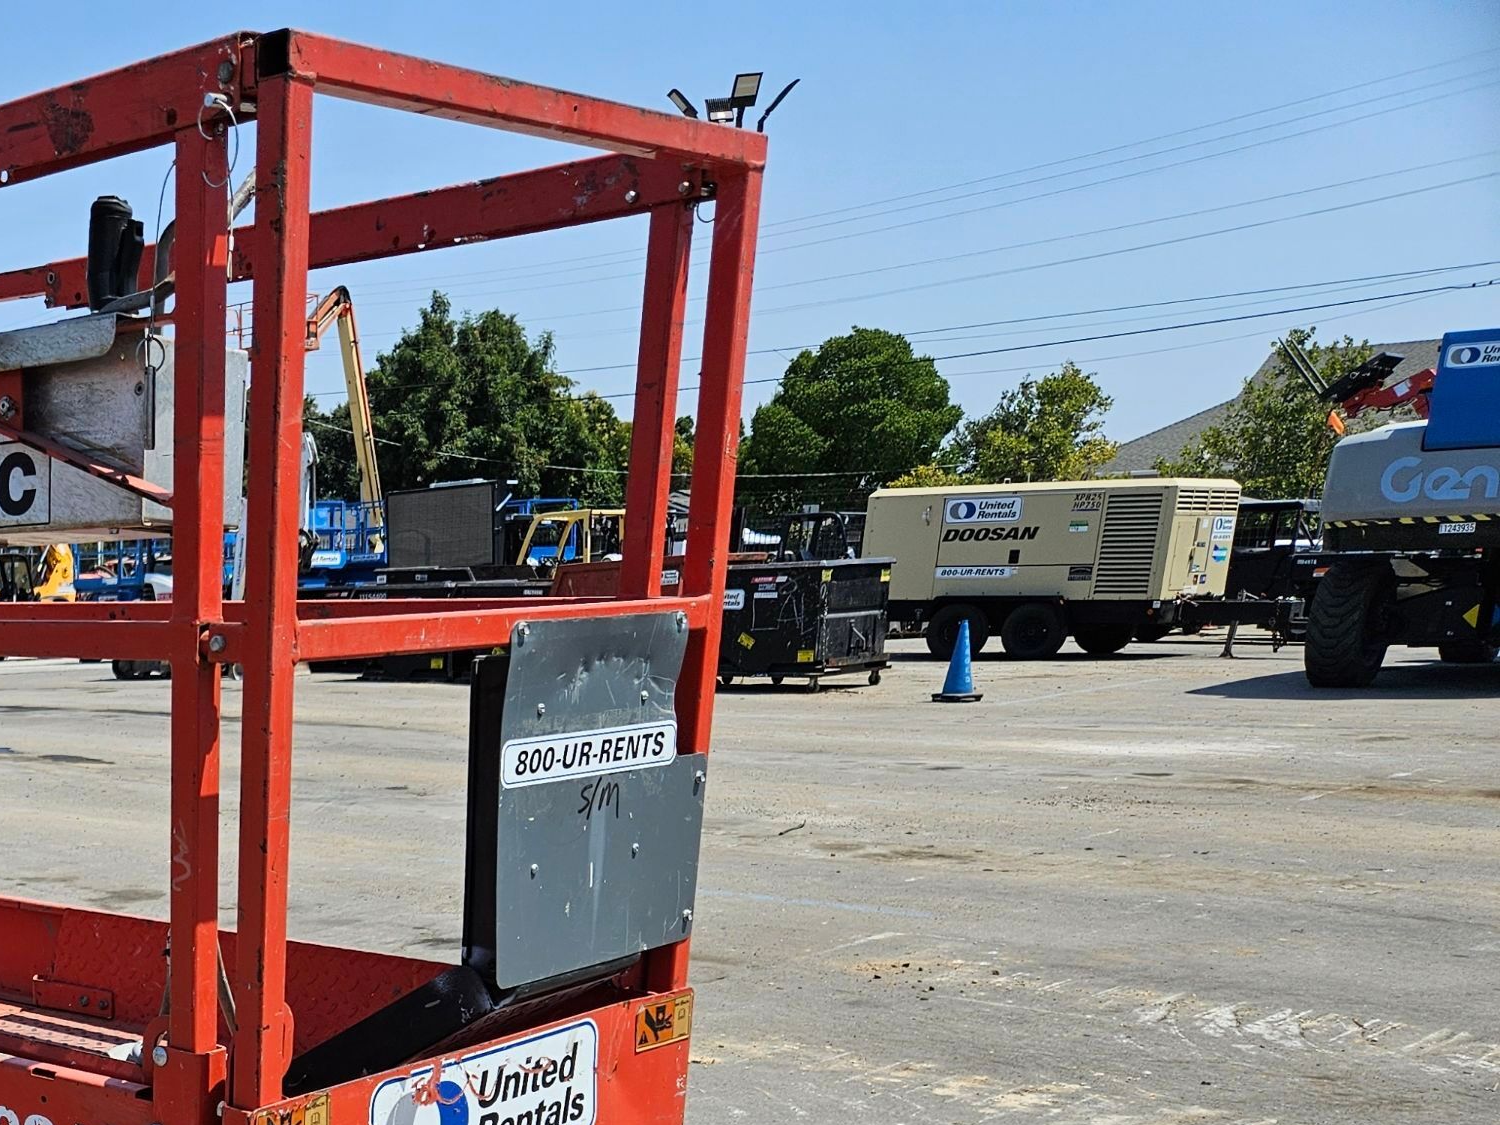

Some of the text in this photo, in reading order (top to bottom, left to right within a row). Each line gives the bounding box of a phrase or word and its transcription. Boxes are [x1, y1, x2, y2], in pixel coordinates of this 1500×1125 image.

[978, 500, 1015, 511] United
[976, 509, 1017, 520] Rentals
[941, 526, 1040, 543] DOOSAN
[940, 567, 1006, 577] 800-UR-RENTS
[514, 731, 665, 776] 800-UR-RENTS
[476, 1041, 579, 1099] United
